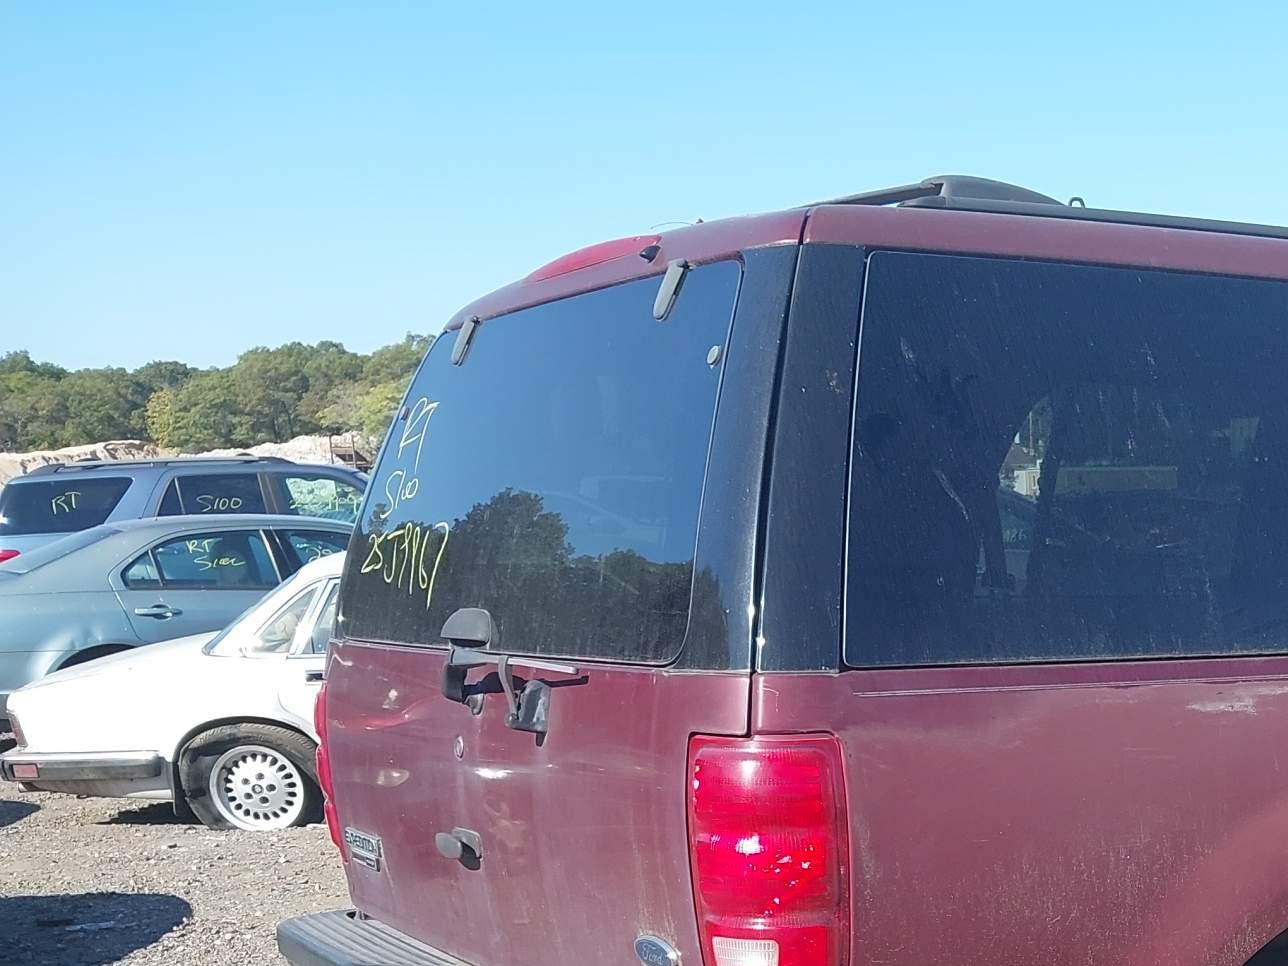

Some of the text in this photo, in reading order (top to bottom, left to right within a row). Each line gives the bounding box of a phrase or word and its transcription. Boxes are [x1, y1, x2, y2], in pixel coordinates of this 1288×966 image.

[52, 491, 80, 514] RT
[196, 494, 242, 512] S100
[186, 537, 223, 554] RT
[360, 522, 449, 610] 25J9967
[641, 943, 669, 966] Ford
